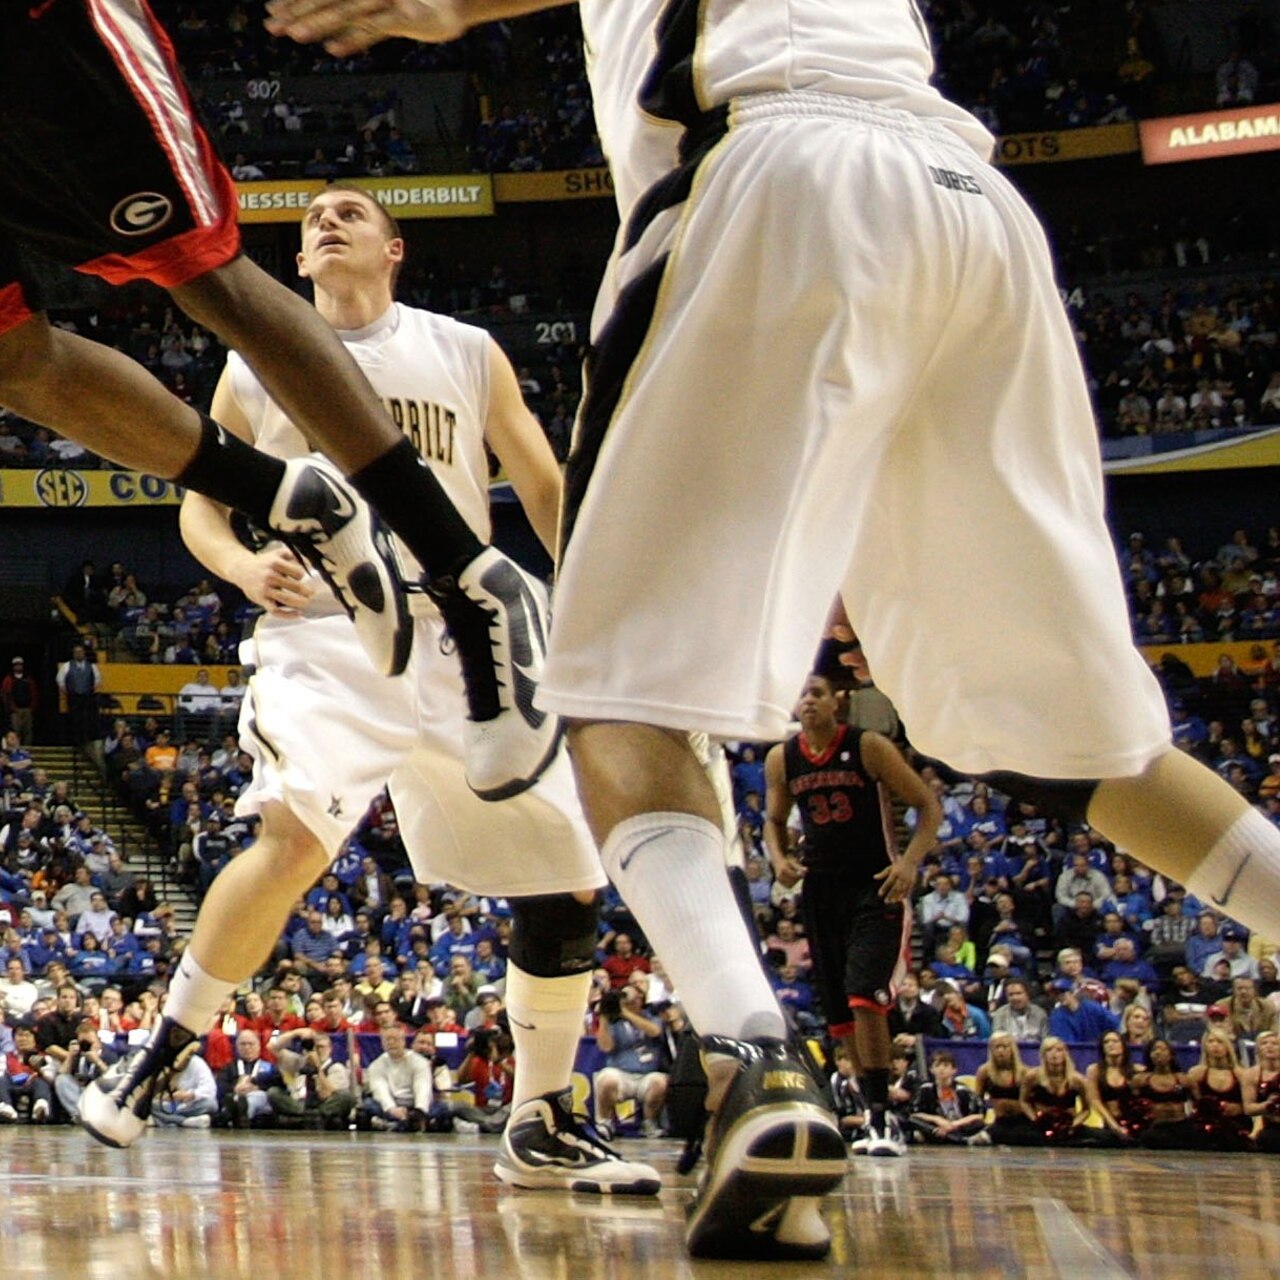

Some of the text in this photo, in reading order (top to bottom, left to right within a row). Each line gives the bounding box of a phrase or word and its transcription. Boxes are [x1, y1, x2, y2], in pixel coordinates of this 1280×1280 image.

[995, 135, 1059, 161] OTS
[367, 185, 479, 206] NDERBILT
[39, 471, 84, 505] SEC
[807, 791, 854, 825] 33
